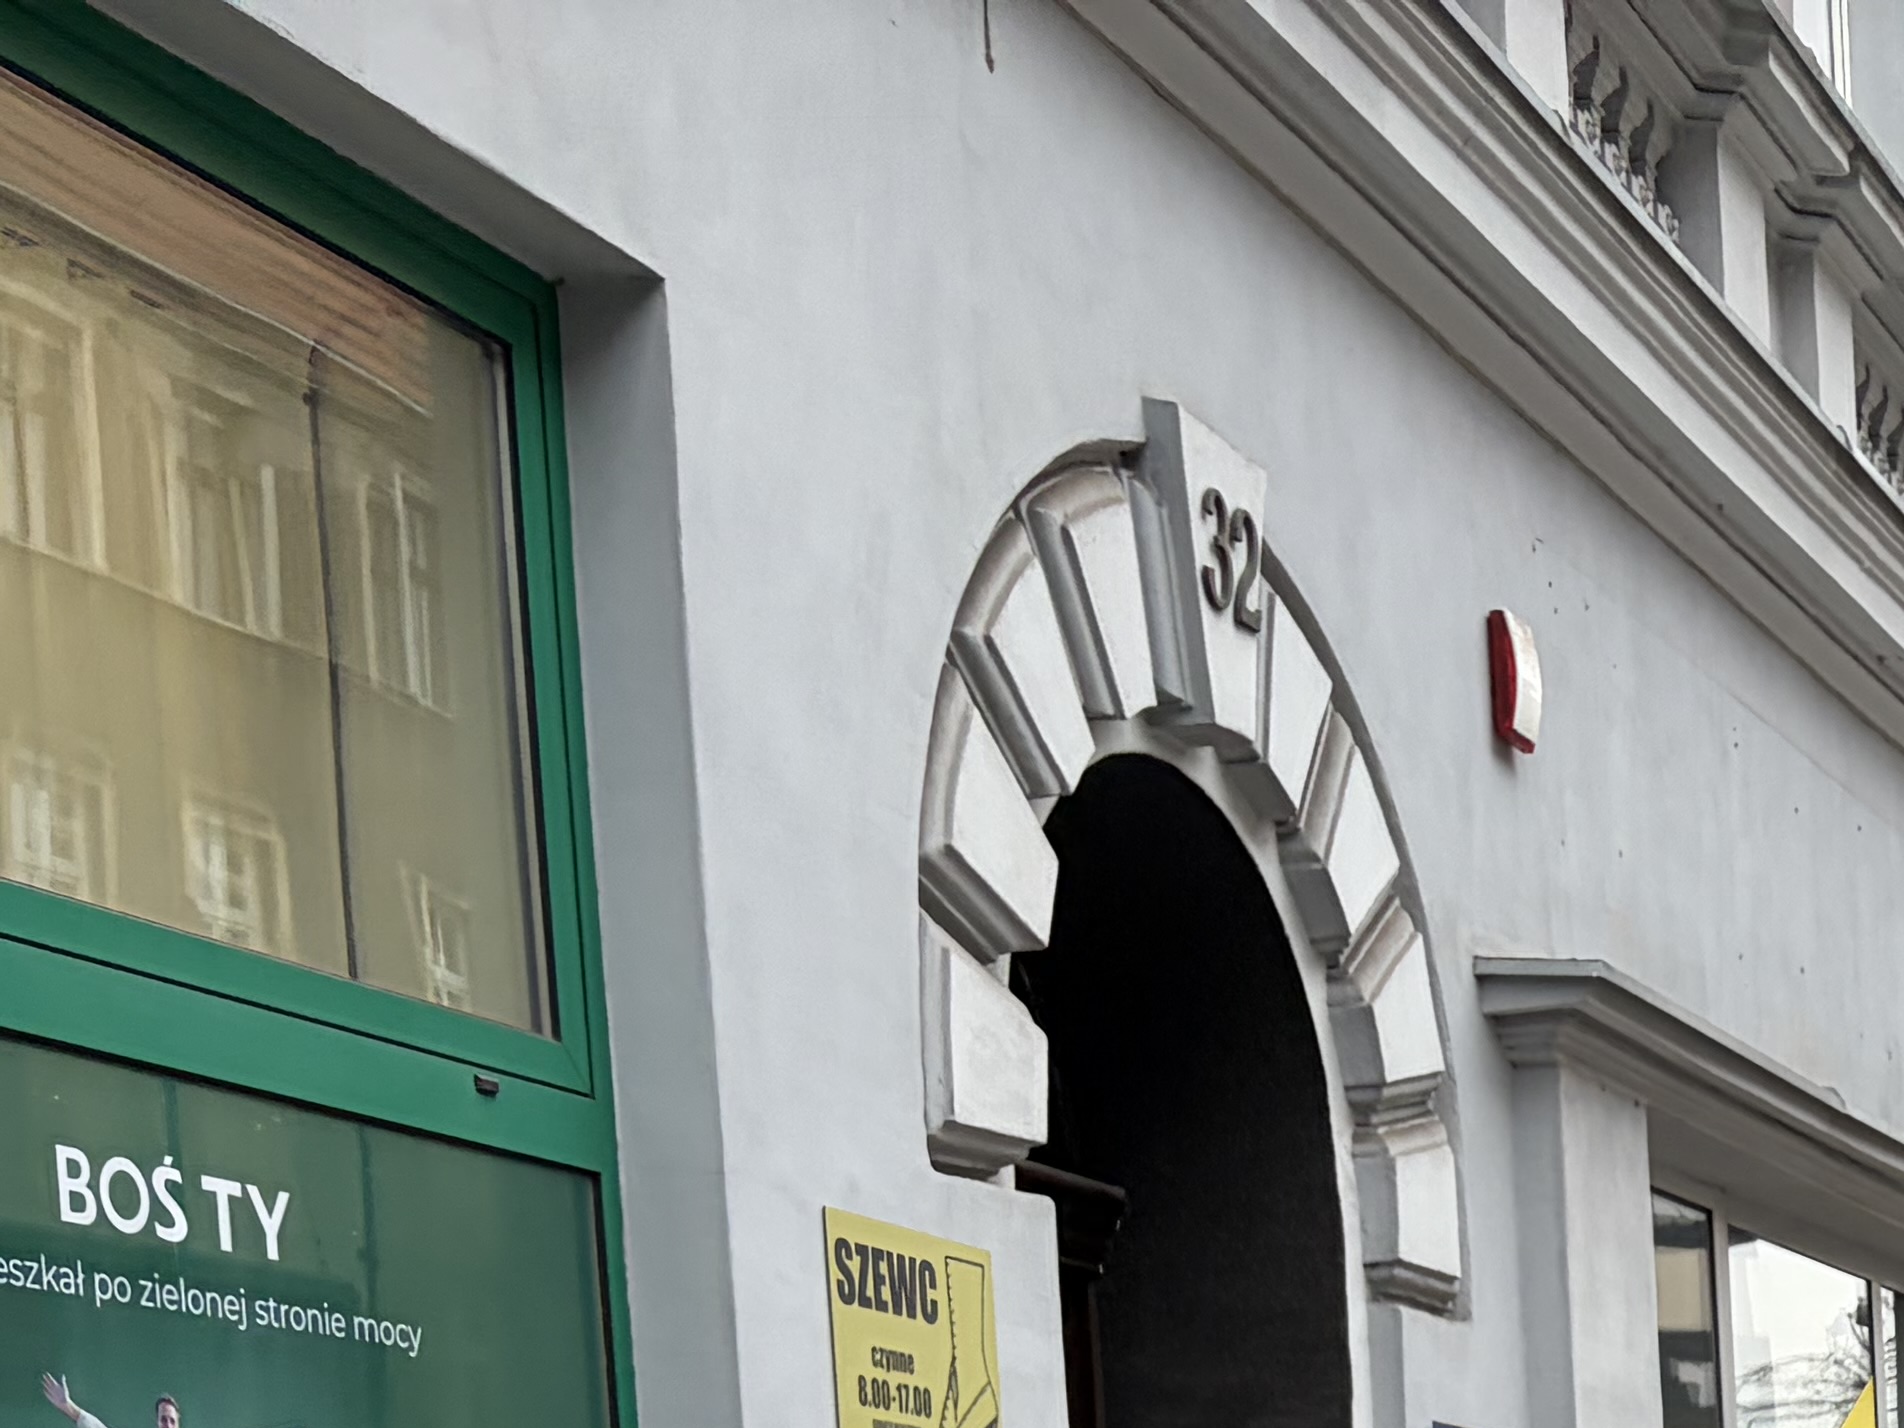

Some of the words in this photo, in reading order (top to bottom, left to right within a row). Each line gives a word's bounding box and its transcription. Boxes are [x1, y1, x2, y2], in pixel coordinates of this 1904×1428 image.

[1201, 488, 1262, 633] 32
[55, 1144, 188, 1243] BOŚ
[201, 1174, 290, 1261] TY
[95, 1271, 132, 1307] po
[139, 1272, 247, 1331] zielonej
[255, 1299, 346, 1338] stronie
[353, 1315, 422, 1357] mocy
[834, 1237, 939, 1325] SZEWC
